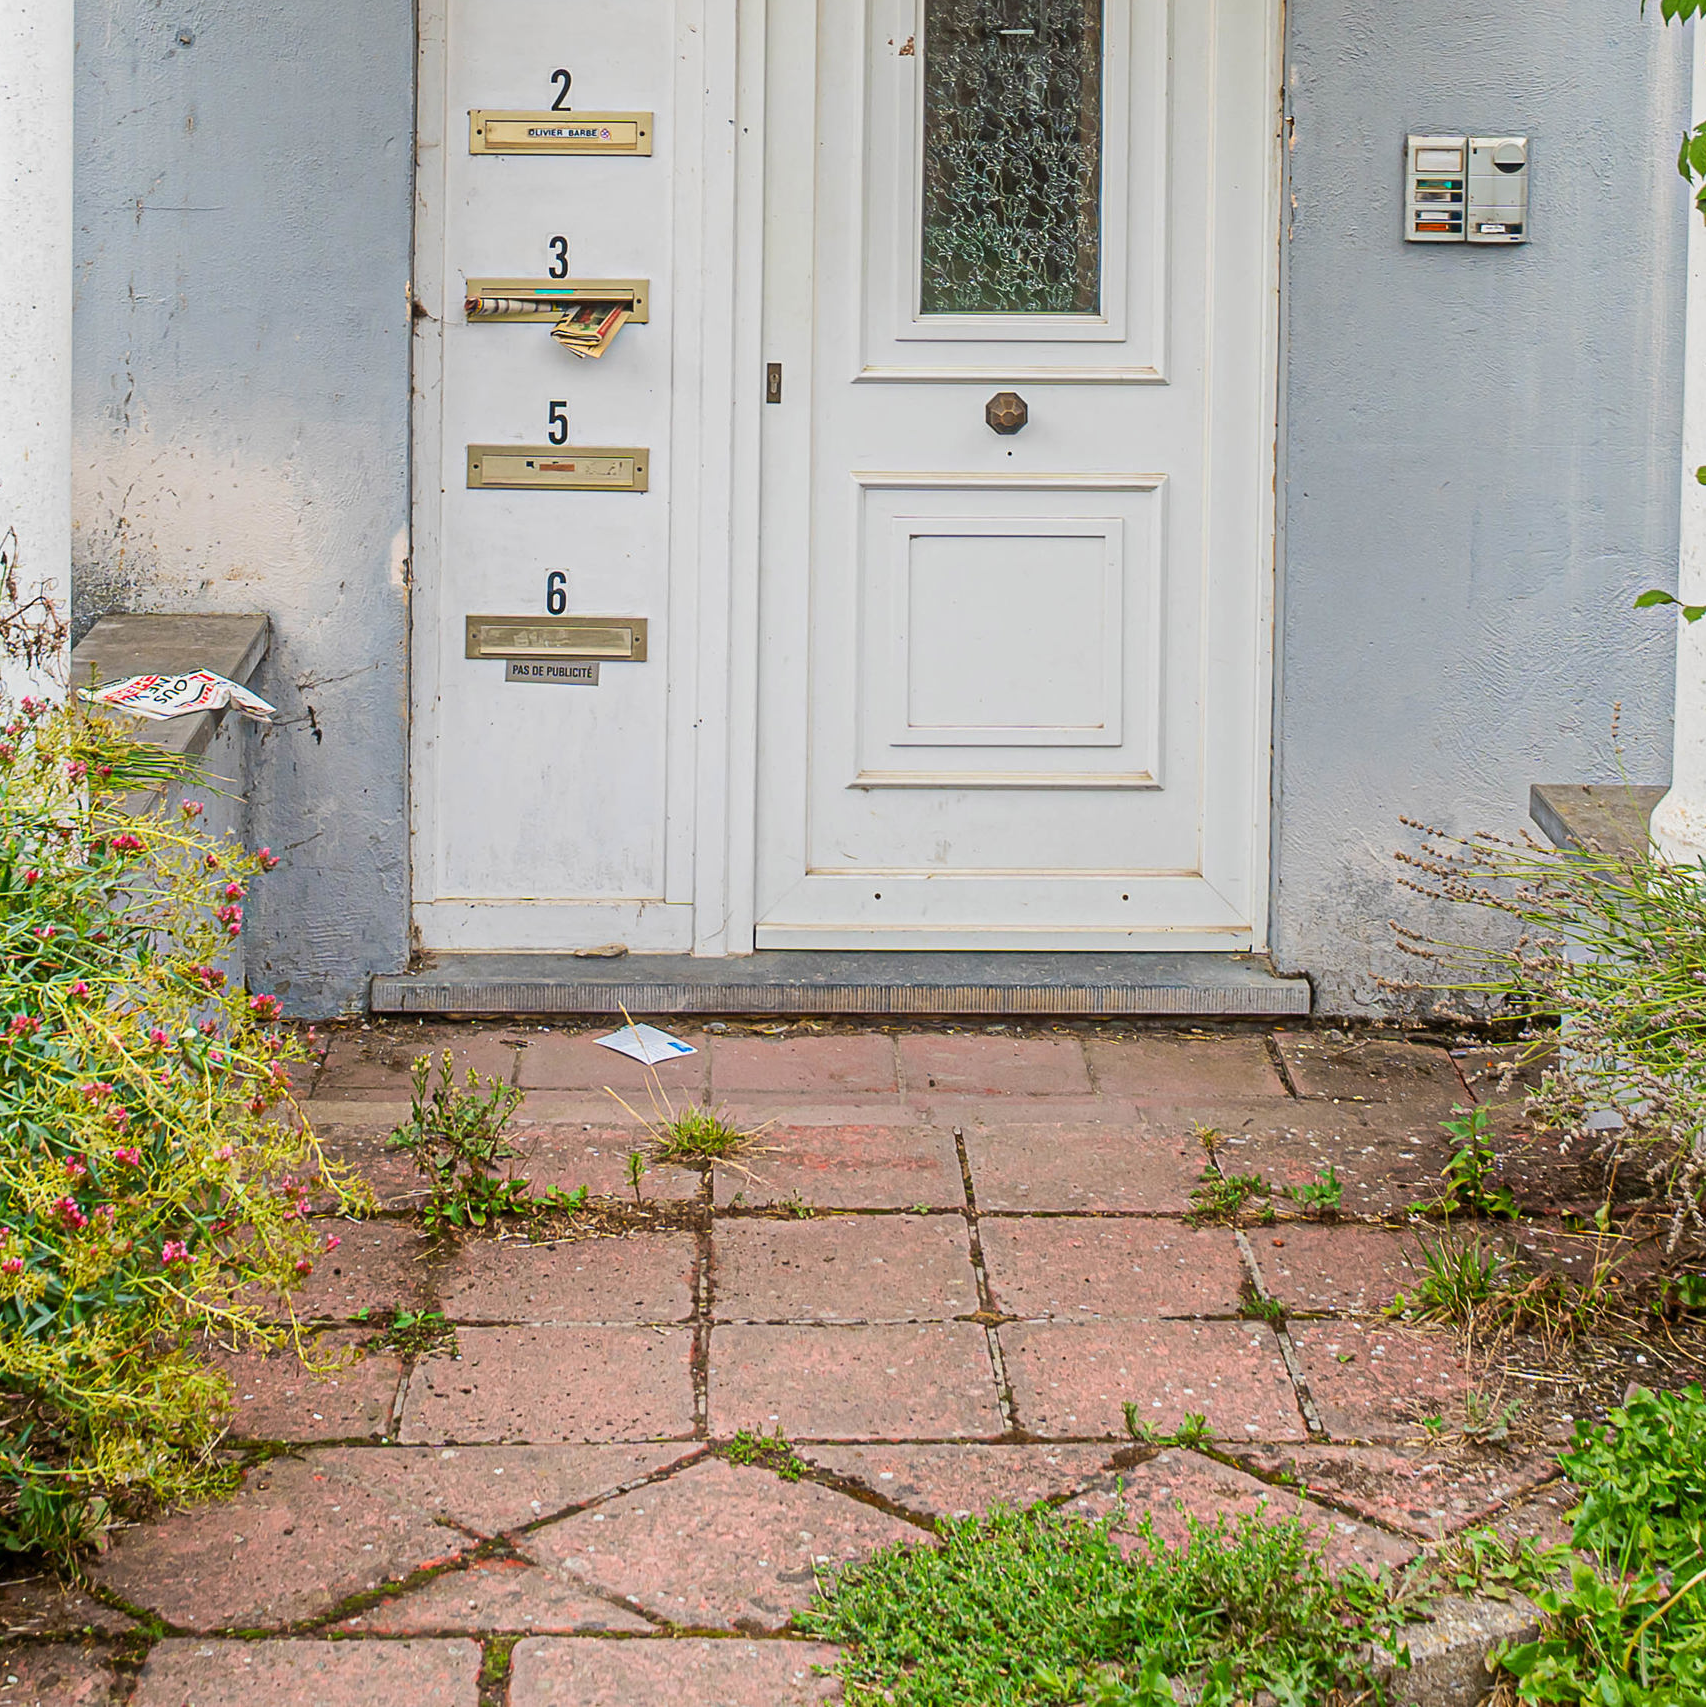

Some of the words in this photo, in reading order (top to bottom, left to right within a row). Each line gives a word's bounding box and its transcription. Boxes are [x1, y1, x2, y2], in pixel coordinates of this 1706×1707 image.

[550, 68, 572, 112] 2
[528, 127, 563, 138] OLIVIER
[548, 235, 569, 279] 3
[548, 400, 568, 446] 5
[546, 571, 567, 616] 6
[512, 664, 530, 675] PAS
[532, 665, 544, 677] DE
[546, 665, 593, 679] PUBLICITÉ
